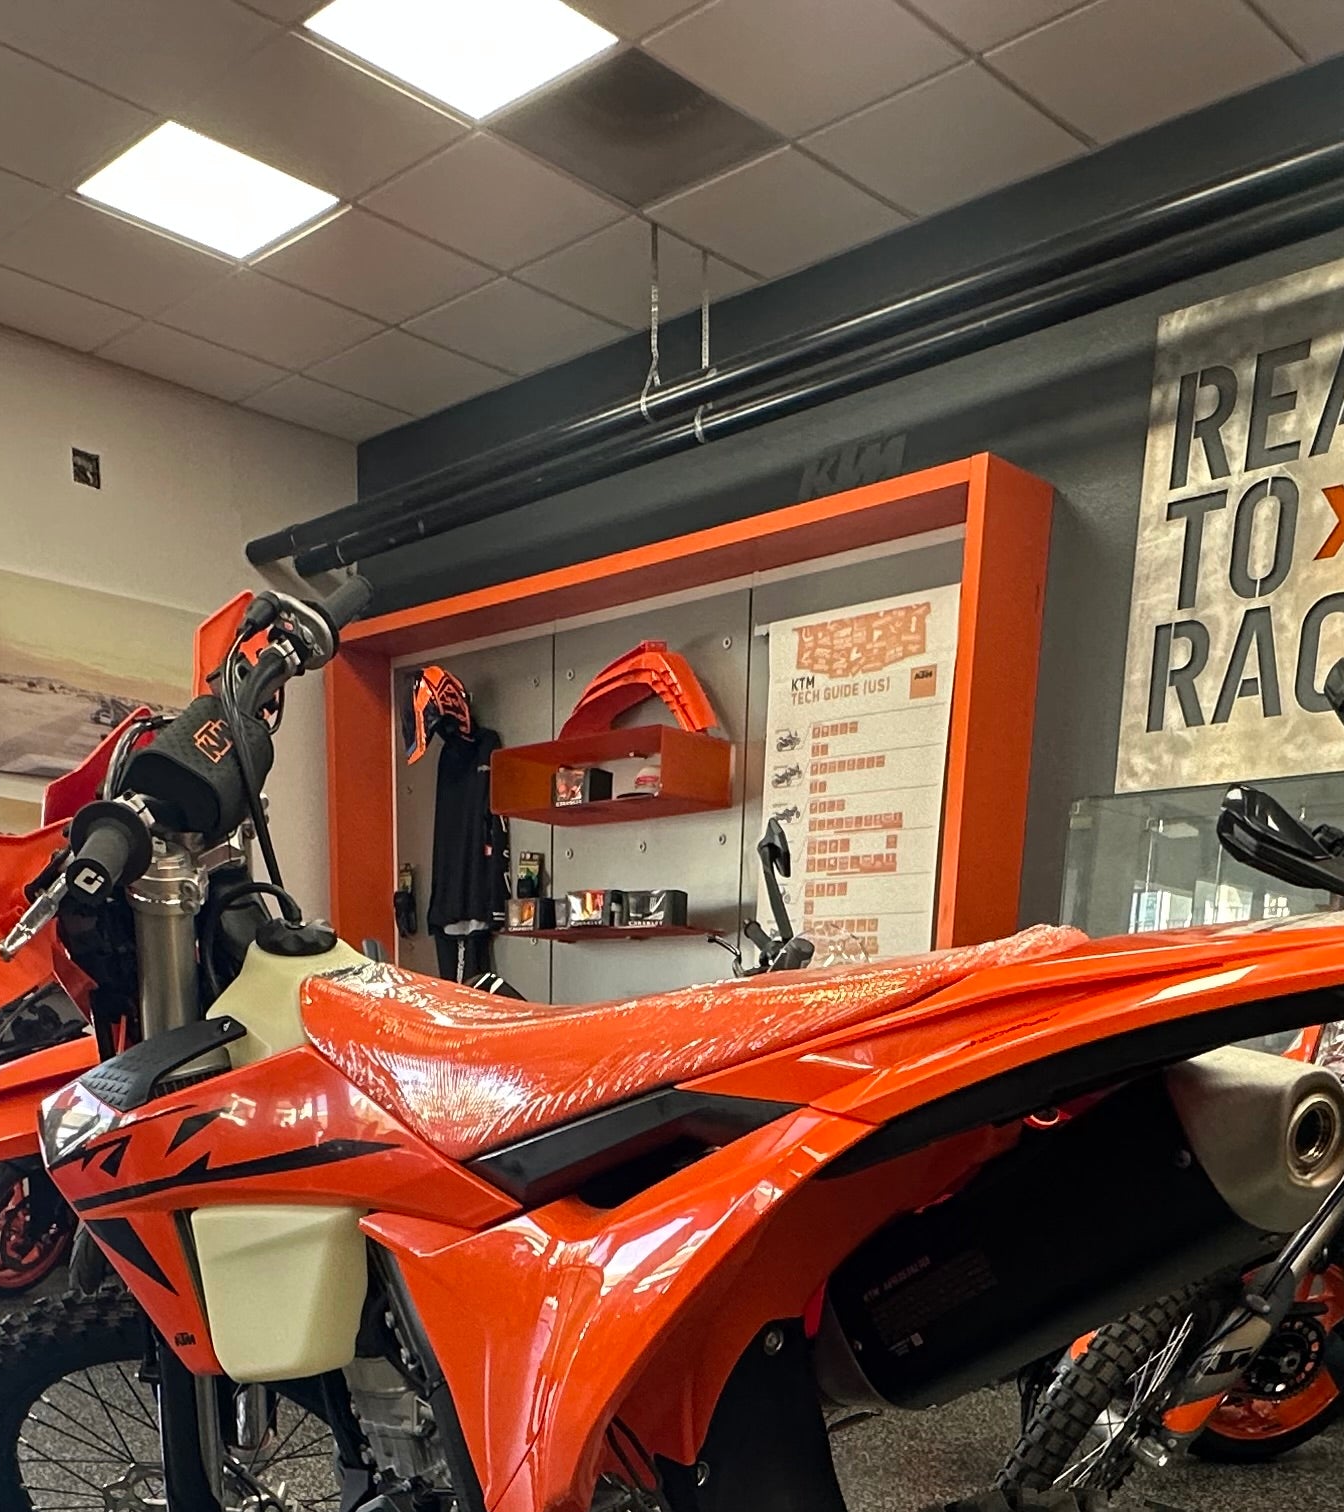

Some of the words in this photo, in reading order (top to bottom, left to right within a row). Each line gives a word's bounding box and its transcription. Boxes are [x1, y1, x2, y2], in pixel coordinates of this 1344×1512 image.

[1167, 476, 1300, 608] TO
[791, 676, 815, 692] KTM
[791, 690, 820, 706] TECH
[824, 683, 859, 701] GUIDE
[863, 677, 890, 695] (US)
[174, 1332, 196, 1347] KTM
